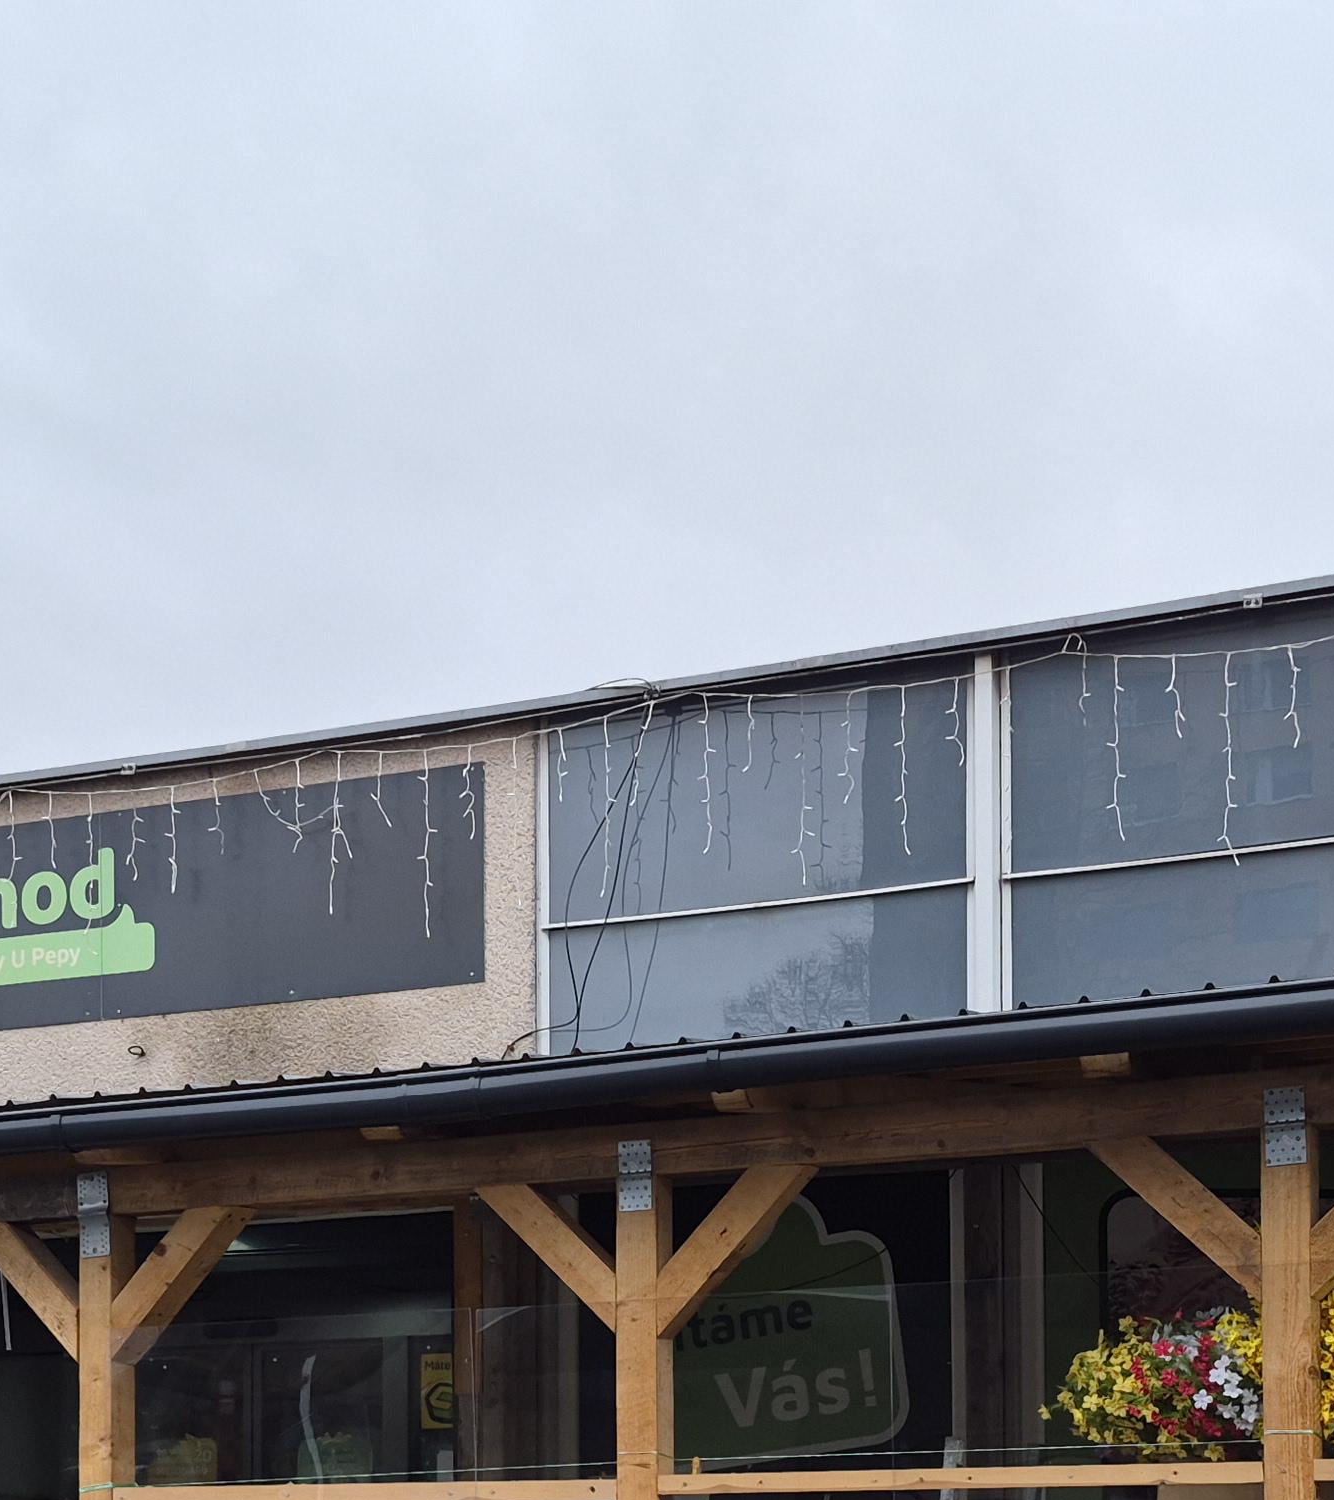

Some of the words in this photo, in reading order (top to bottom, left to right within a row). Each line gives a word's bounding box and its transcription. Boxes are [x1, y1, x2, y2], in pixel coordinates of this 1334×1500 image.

[11, 950, 25, 969] U
[32, 947, 81, 968] Pepy
[713, 1347, 878, 1429] Vás!
